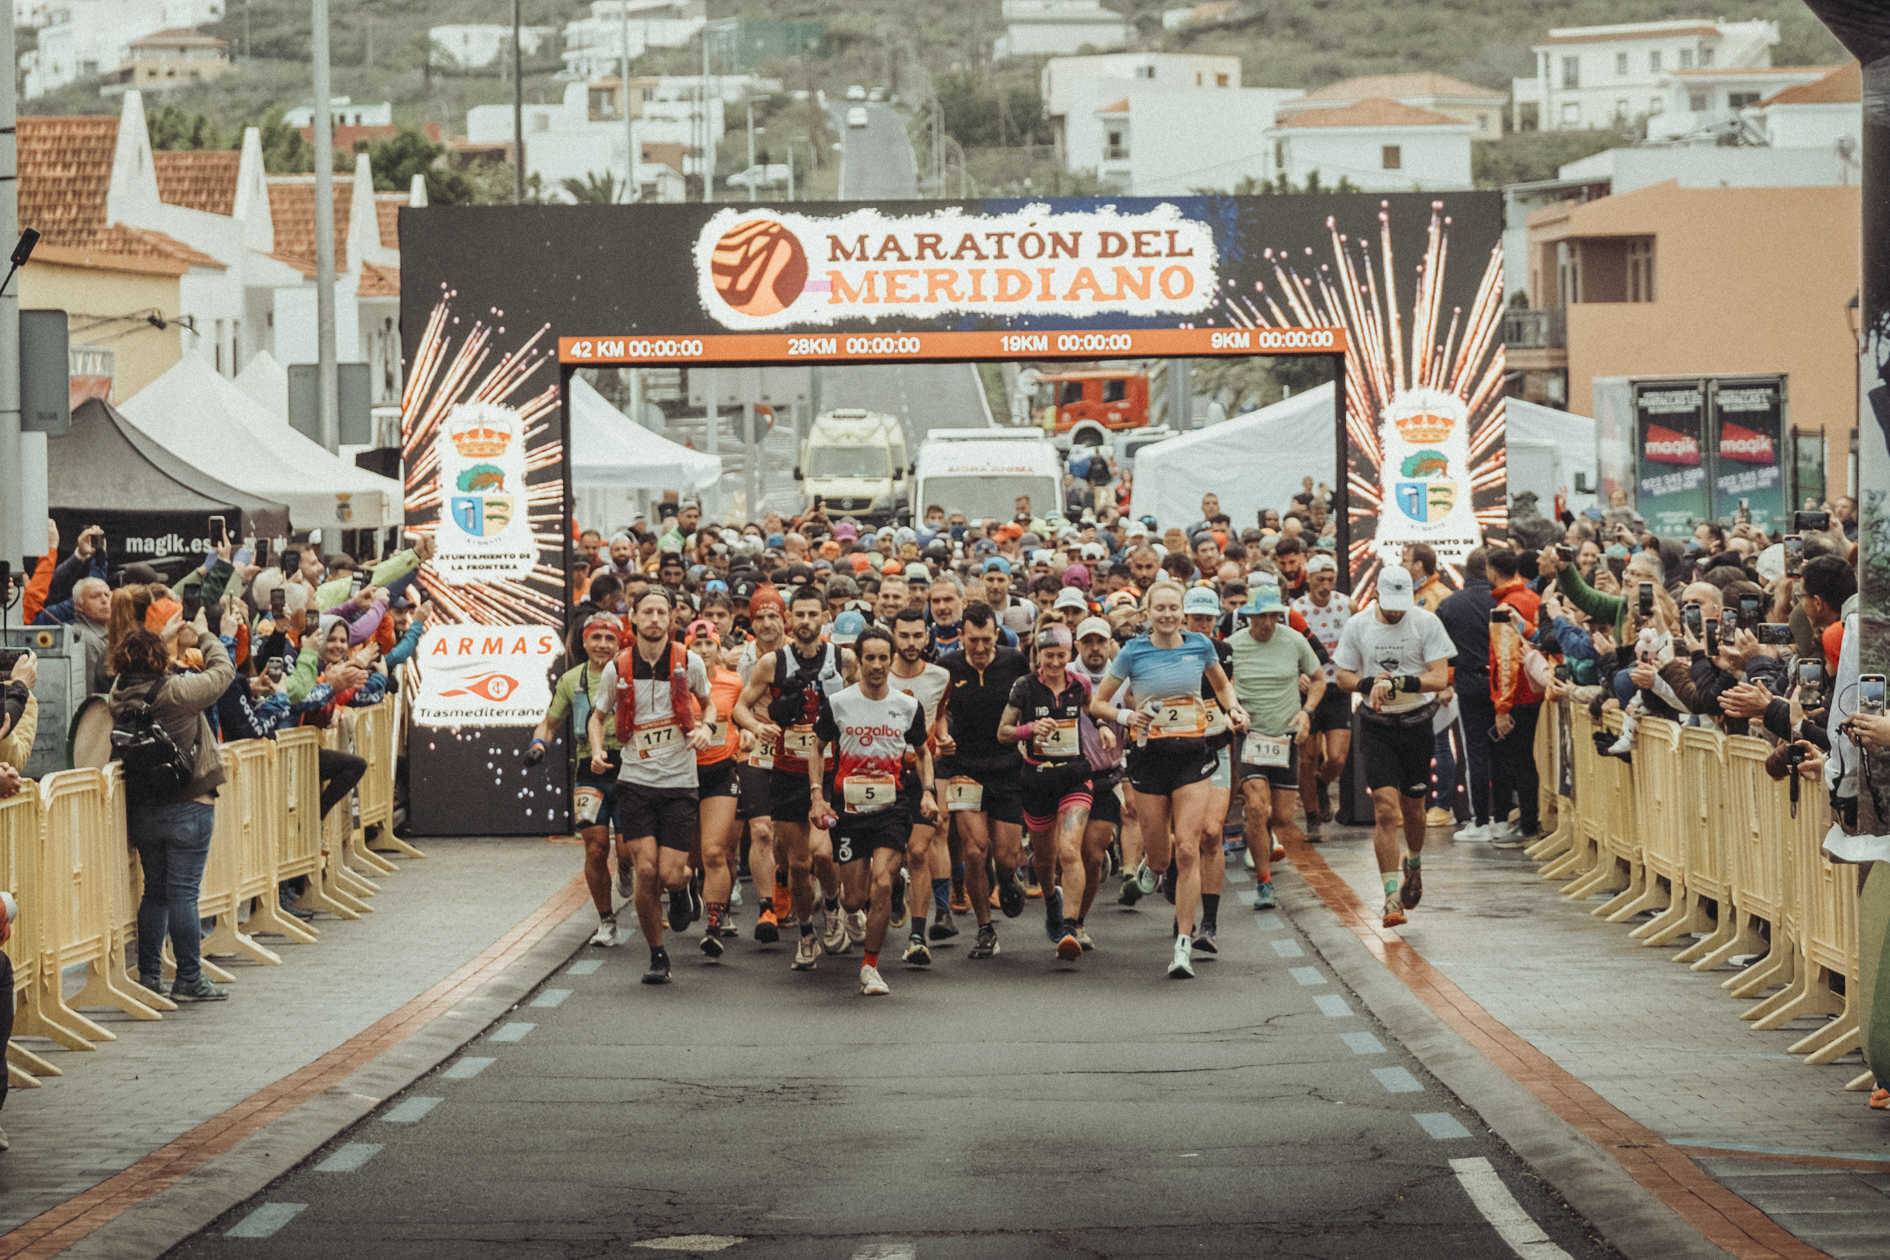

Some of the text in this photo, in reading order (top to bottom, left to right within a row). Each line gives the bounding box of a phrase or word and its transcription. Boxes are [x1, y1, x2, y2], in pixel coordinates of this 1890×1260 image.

[826, 222, 1194, 262] MARATÓN DEL
[825, 265, 1195, 304] MERIDIANO
[570, 340, 703, 358] 42 KM 00:00:00
[787, 337, 920, 355] 28KM 00:00:00
[1000, 334, 1132, 352] 19KM 00:00:00
[1211, 331, 1334, 349] 9KM 00:00:00
[1645, 436, 1697, 456] magik
[1720, 434, 1771, 455] magik
[126, 534, 211, 557] magik.es
[439, 553, 516, 561] AYUNTAMIENTO
[432, 635, 553, 656] ARMAS
[1168, 709, 1178, 722] 2
[643, 728, 673, 745] 177
[1051, 730, 1061, 742] 4
[1255, 743, 1280, 755] 116
[865, 787, 875, 800] 5
[956, 786, 963, 797] 1
